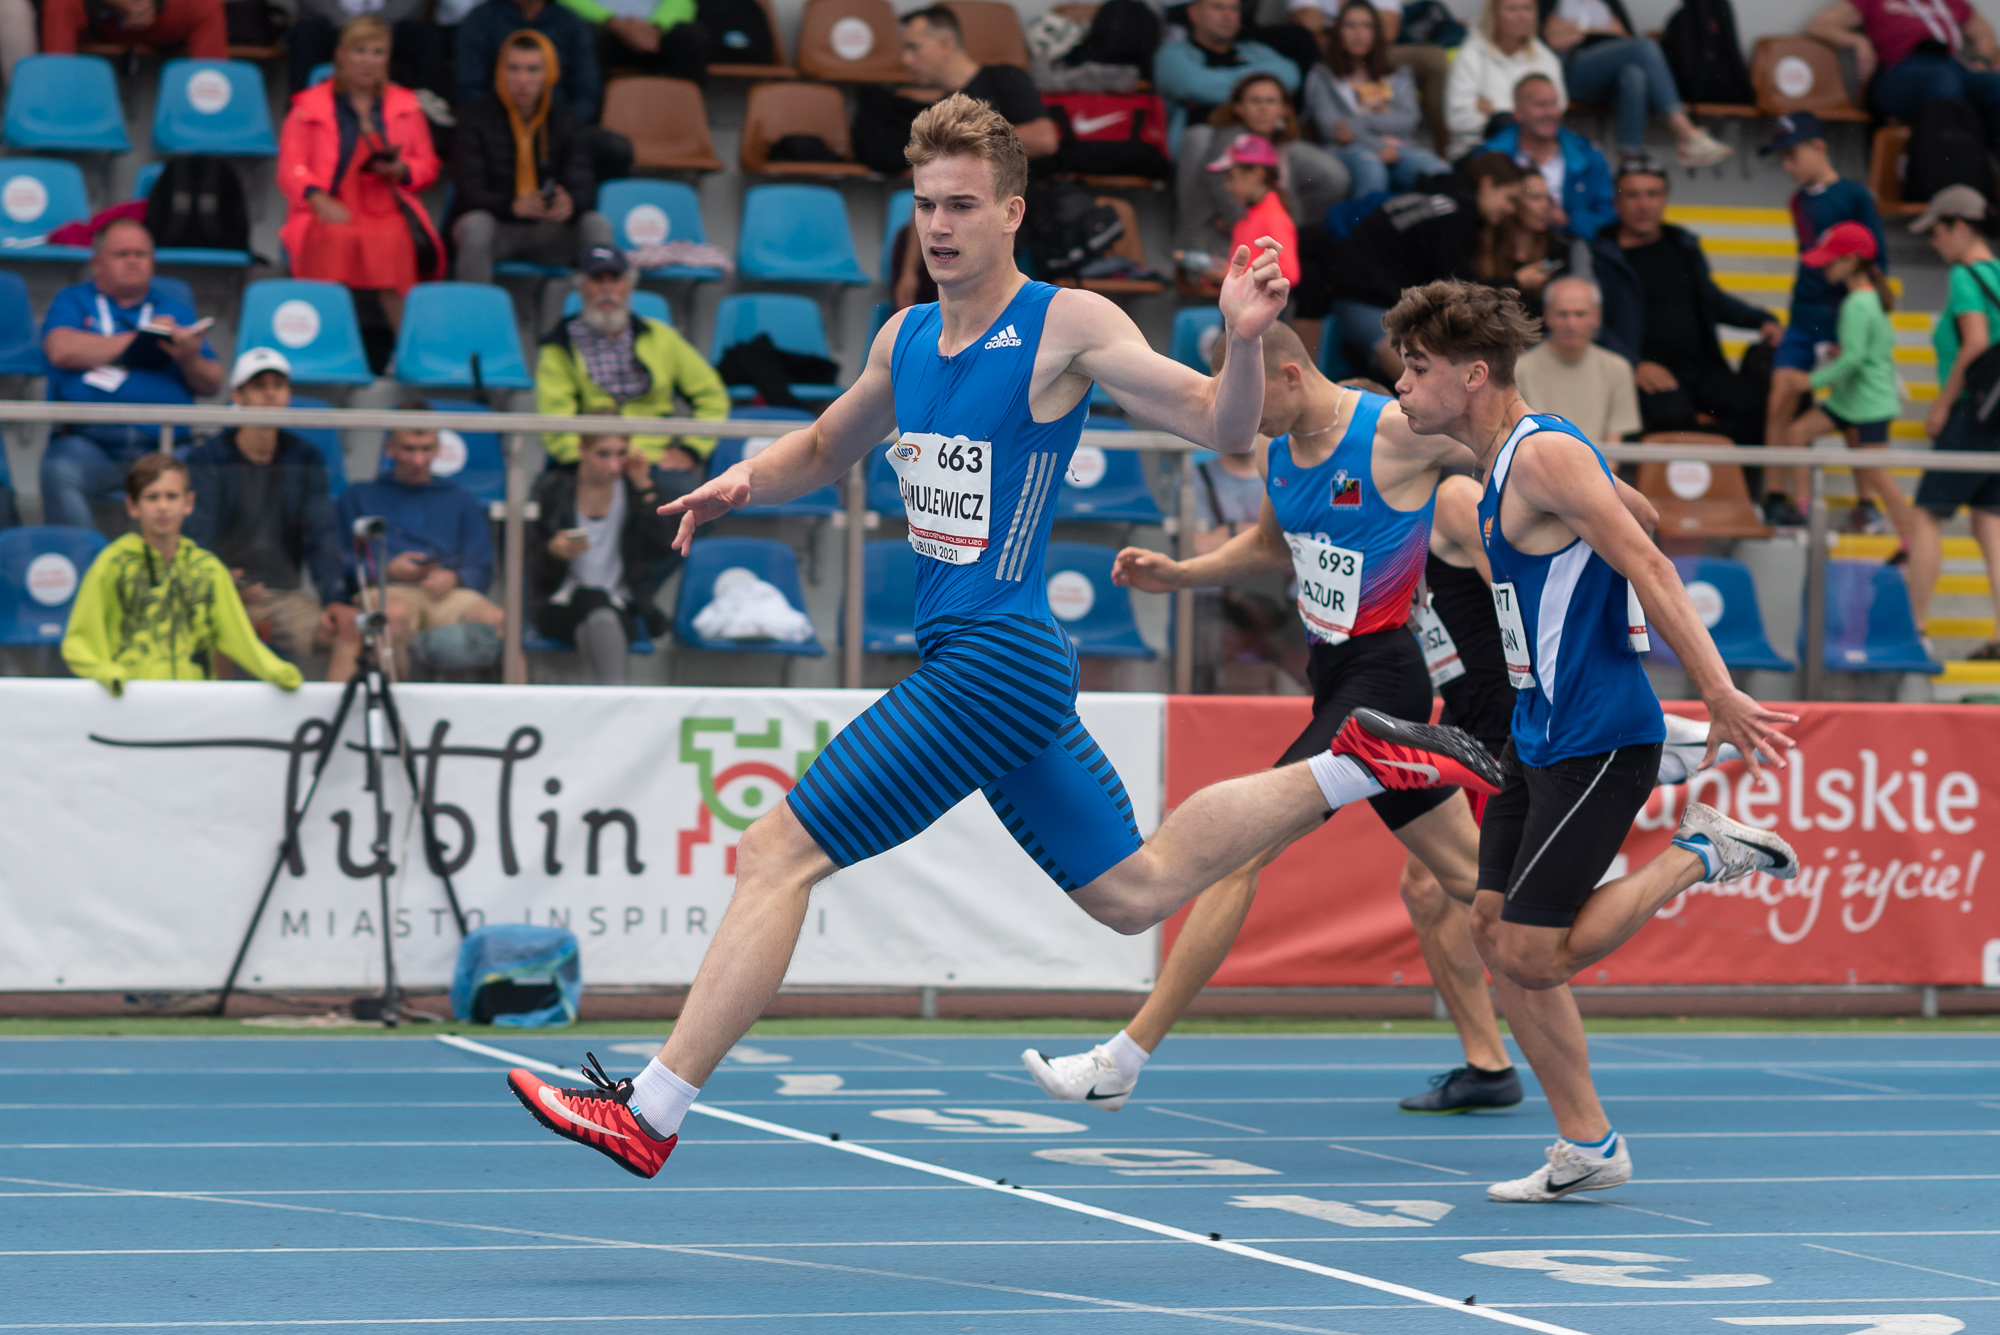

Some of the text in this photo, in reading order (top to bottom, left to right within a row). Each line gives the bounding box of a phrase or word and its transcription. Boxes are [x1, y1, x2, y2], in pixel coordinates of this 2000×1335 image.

[984, 338, 1022, 350] adidas
[937, 442, 983, 474] 663
[938, 545, 958, 562] 2021
[1318, 549, 1355, 577] 693
[1300, 577, 1345, 613] AZUR
[523, 905, 827, 939] INSPIRI
